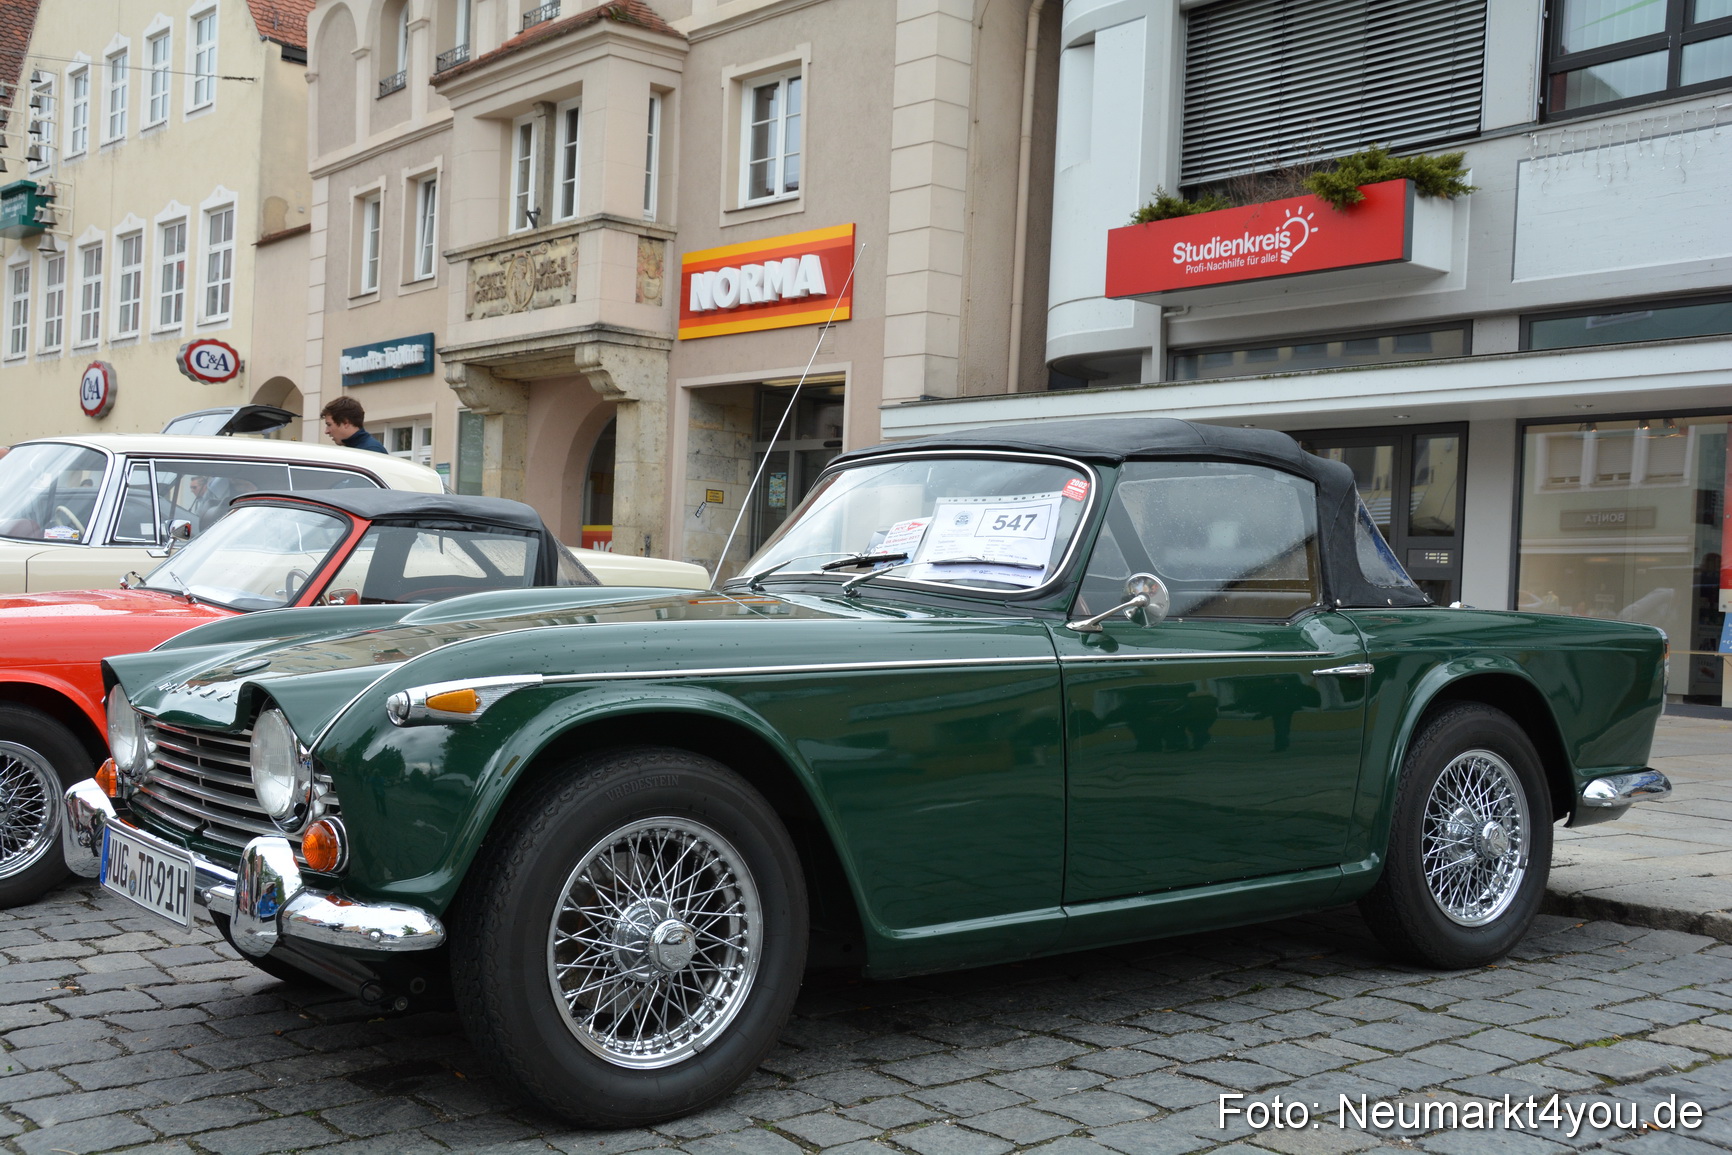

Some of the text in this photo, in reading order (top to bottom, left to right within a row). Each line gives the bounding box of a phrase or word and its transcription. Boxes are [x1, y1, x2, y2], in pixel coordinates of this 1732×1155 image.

[1173, 226, 1291, 264] Studienkreis
[1185, 252, 1279, 274] Profi-Nachhilfe für alle!
[690, 254, 827, 312] NORMA
[195, 350, 231, 372] C&A
[82, 376, 102, 401] C&A
[992, 513, 1038, 532] 547
[606, 774, 680, 802] VREDESTEIN
